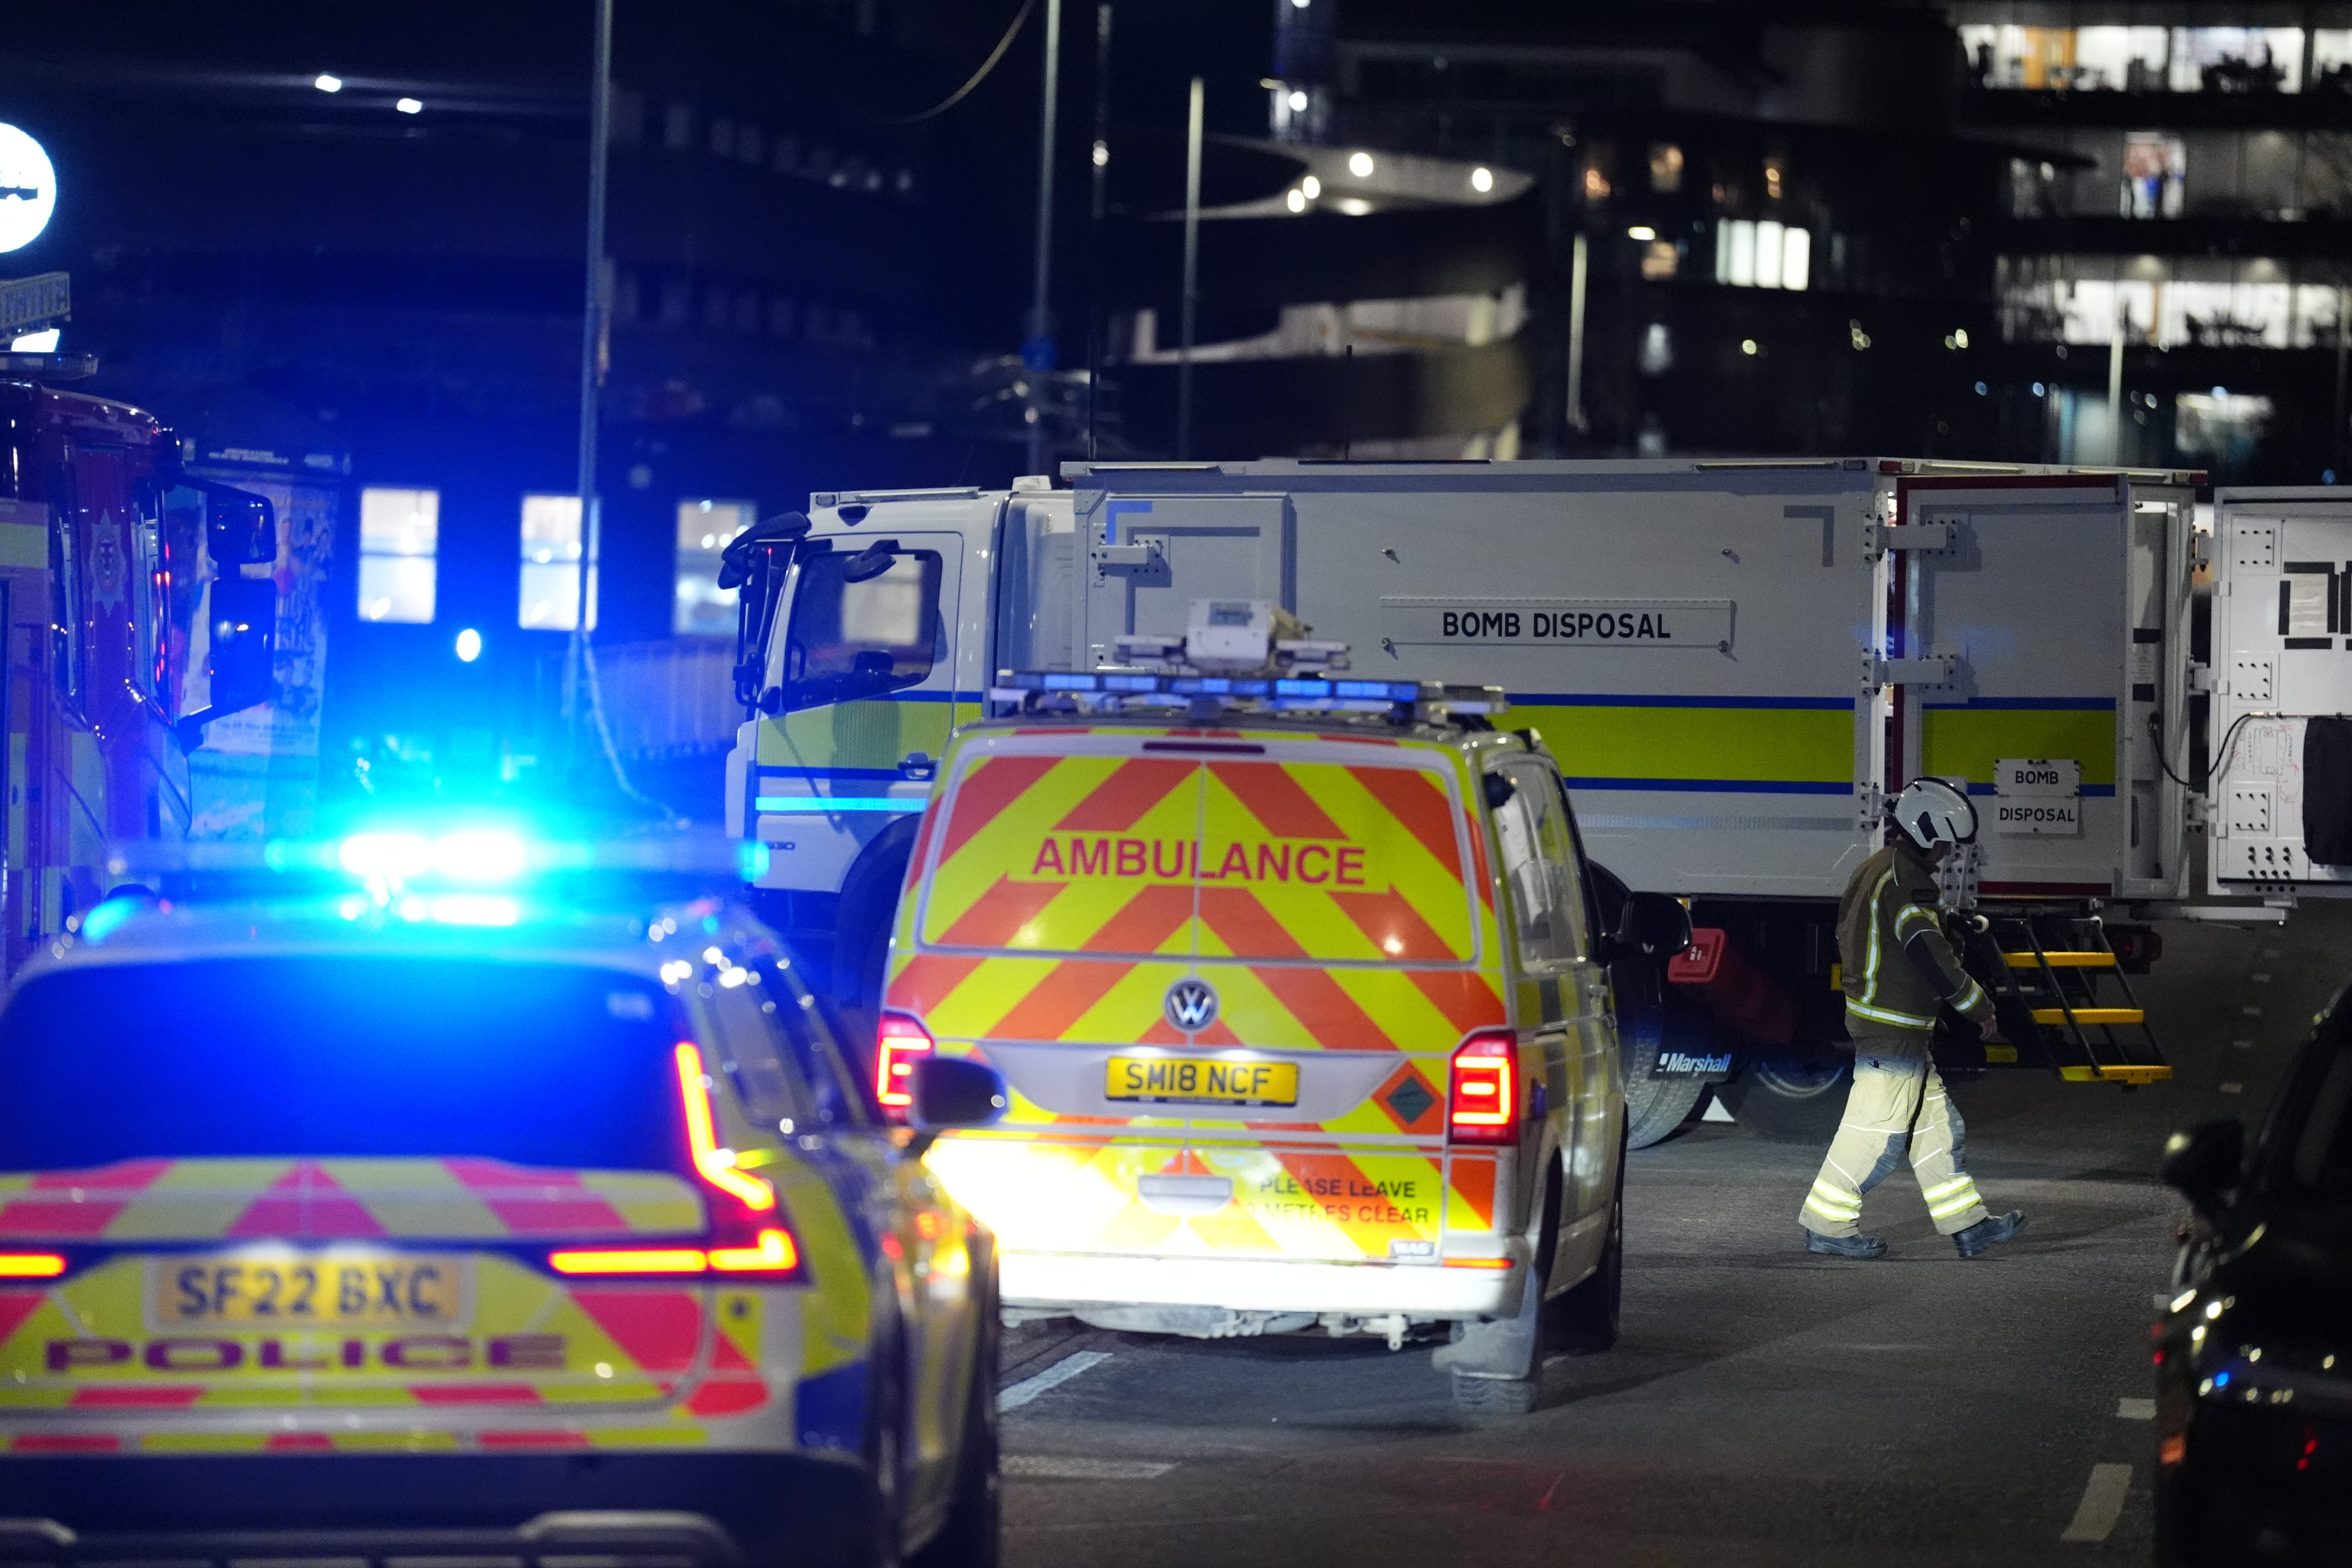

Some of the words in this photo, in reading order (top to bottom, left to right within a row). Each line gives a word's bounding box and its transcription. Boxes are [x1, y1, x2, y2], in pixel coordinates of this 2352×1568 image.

[1443, 612, 1520, 637] BOMB
[1533, 613, 1671, 638] DISPOSAL
[2015, 770, 2059, 784] BOMB
[2000, 807, 2075, 822] DISPOSAL
[1031, 836, 1366, 886] AMBULANCE
[1666, 1053, 1731, 1072] Marshall
[1126, 1063, 1196, 1092] SM18
[1208, 1065, 1271, 1094] NCF
[1350, 1180, 1416, 1198] LEAVE
[1358, 1205, 1428, 1223] CLEAR
[176, 1265, 316, 1316] SF22
[45, 1334, 567, 1372] POLICE
